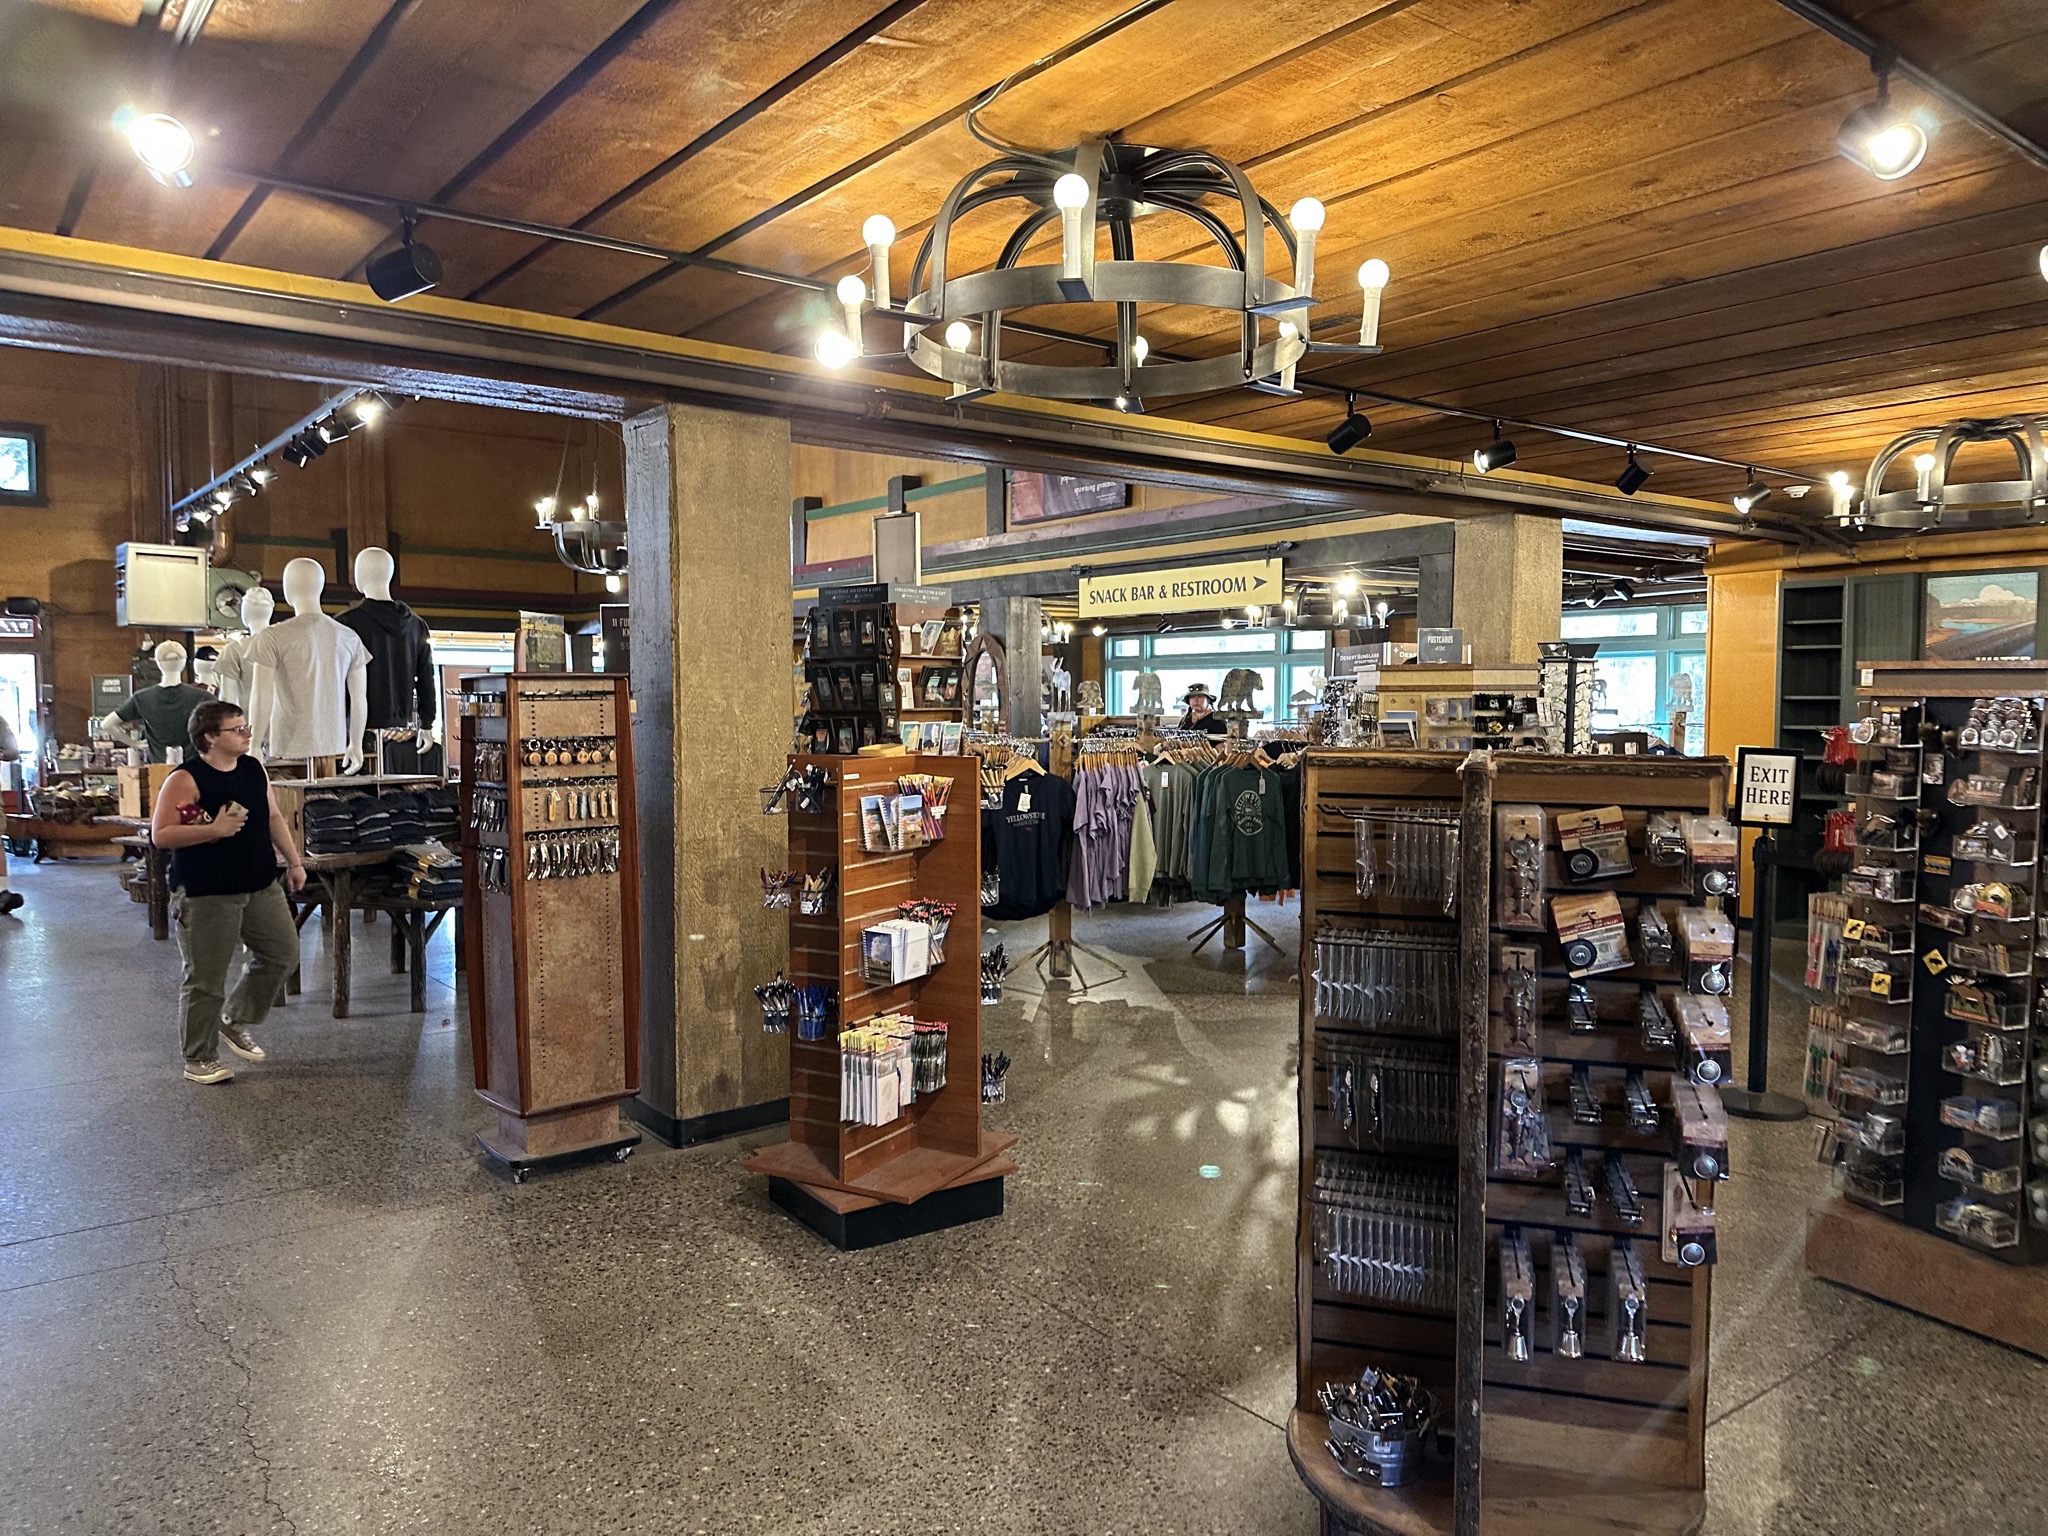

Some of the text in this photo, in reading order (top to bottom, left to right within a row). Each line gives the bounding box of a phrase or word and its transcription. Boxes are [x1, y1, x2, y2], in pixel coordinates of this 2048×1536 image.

[1089, 576, 1247, 605] SNACK BAR & RESTROOM
[1427, 635, 1454, 644] POSTCARDS
[1750, 766, 1789, 783] EXIT
[1745, 787, 1790, 805] HERE
[1006, 812, 1046, 823] YELLOWSTOE
